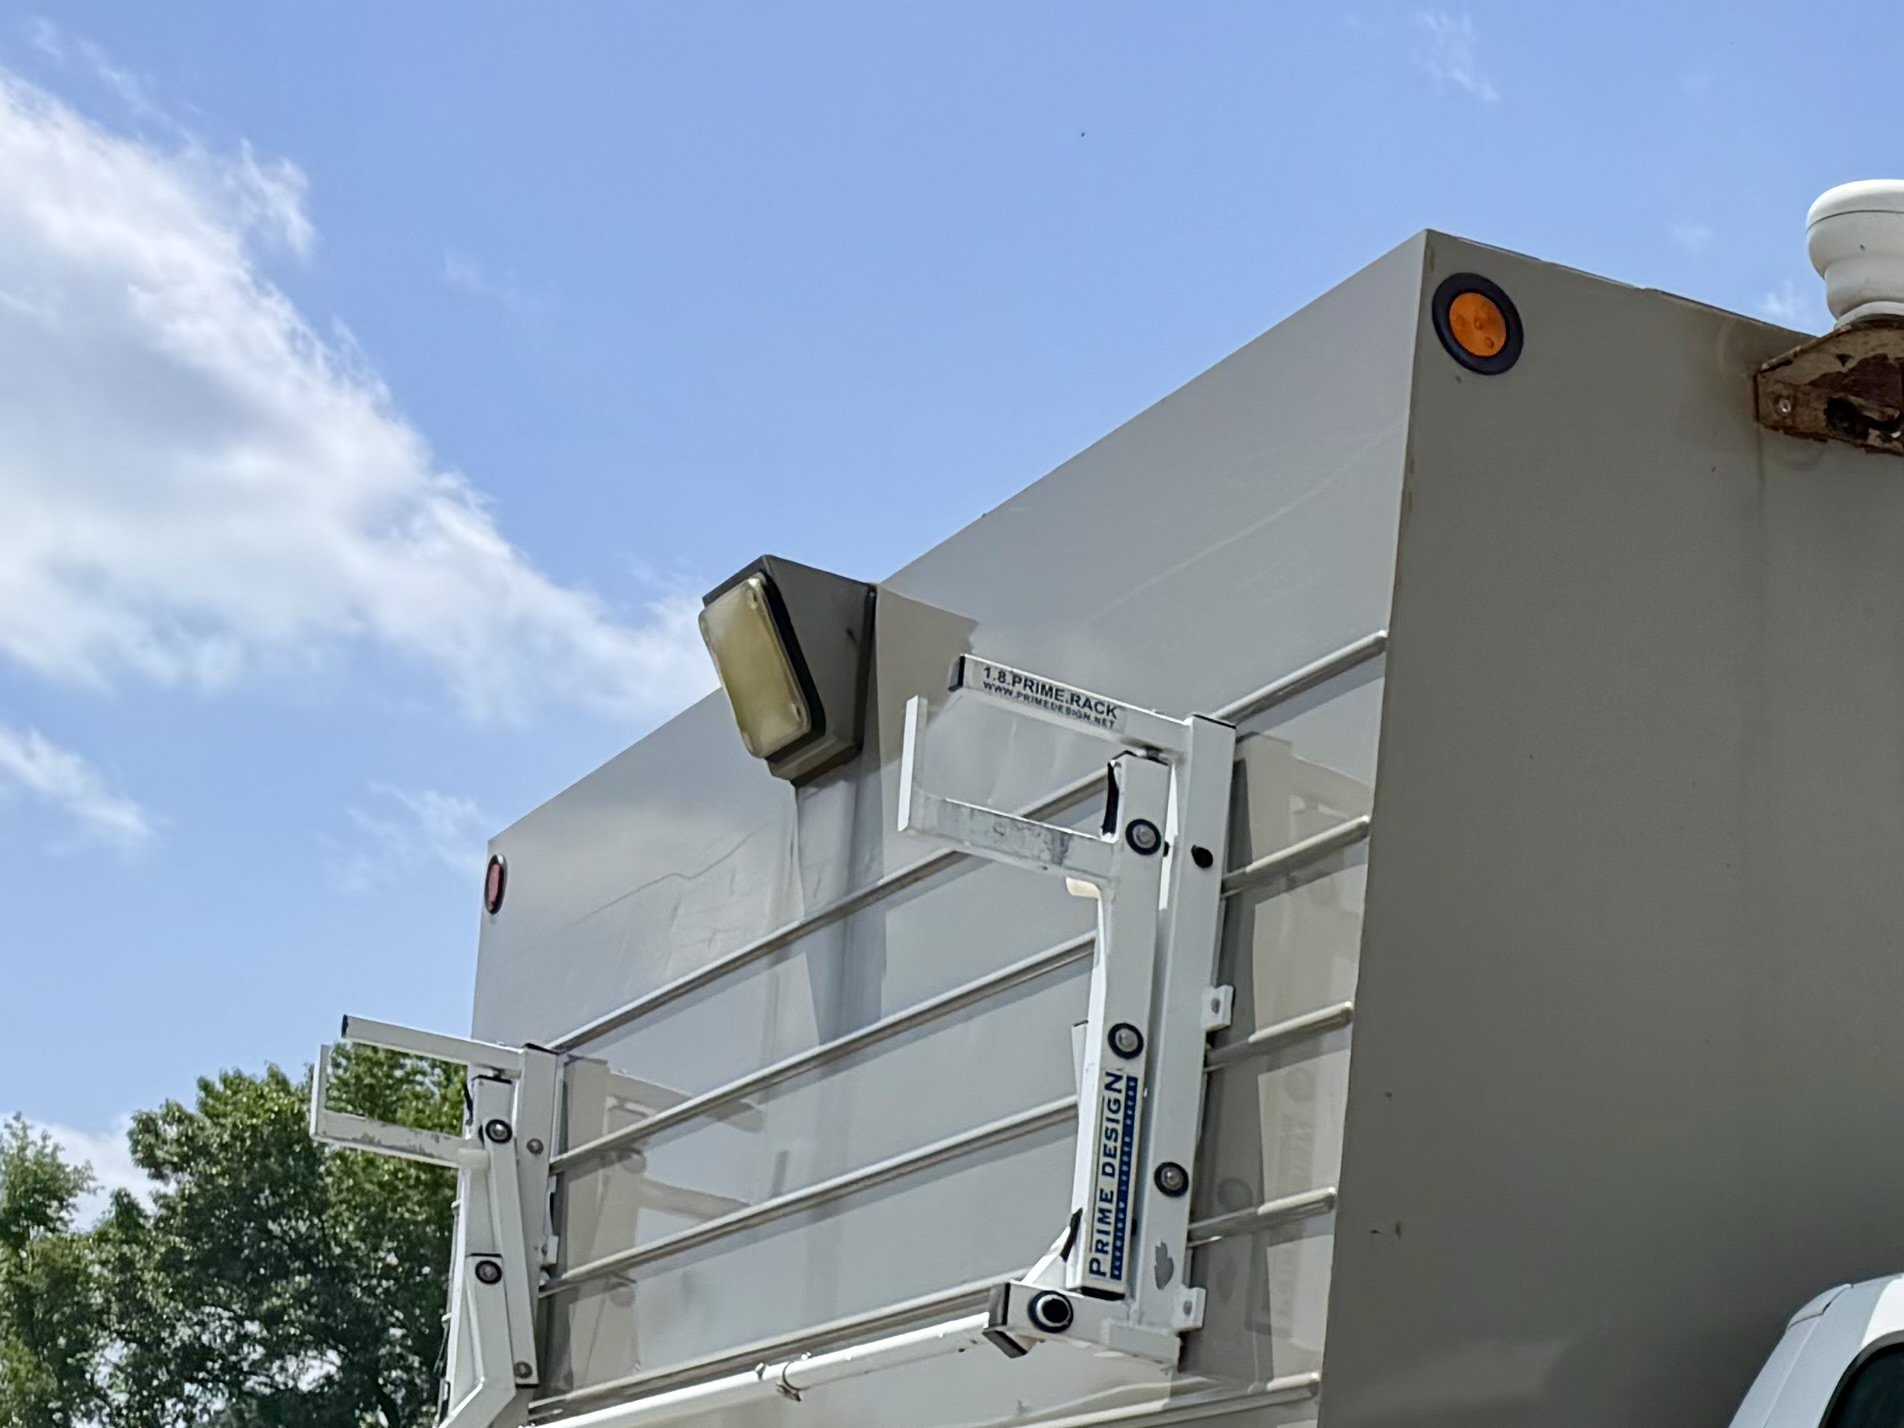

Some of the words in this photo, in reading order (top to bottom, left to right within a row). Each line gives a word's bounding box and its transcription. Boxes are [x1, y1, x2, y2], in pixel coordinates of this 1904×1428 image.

[982, 680, 1116, 729] WWW.PRIMEDESIGN.NET
[983, 666, 1118, 720] 1.8.PRIME.RACK
[1088, 1188, 1114, 1278] PRIME
[1101, 1070, 1125, 1179] DESIGN
